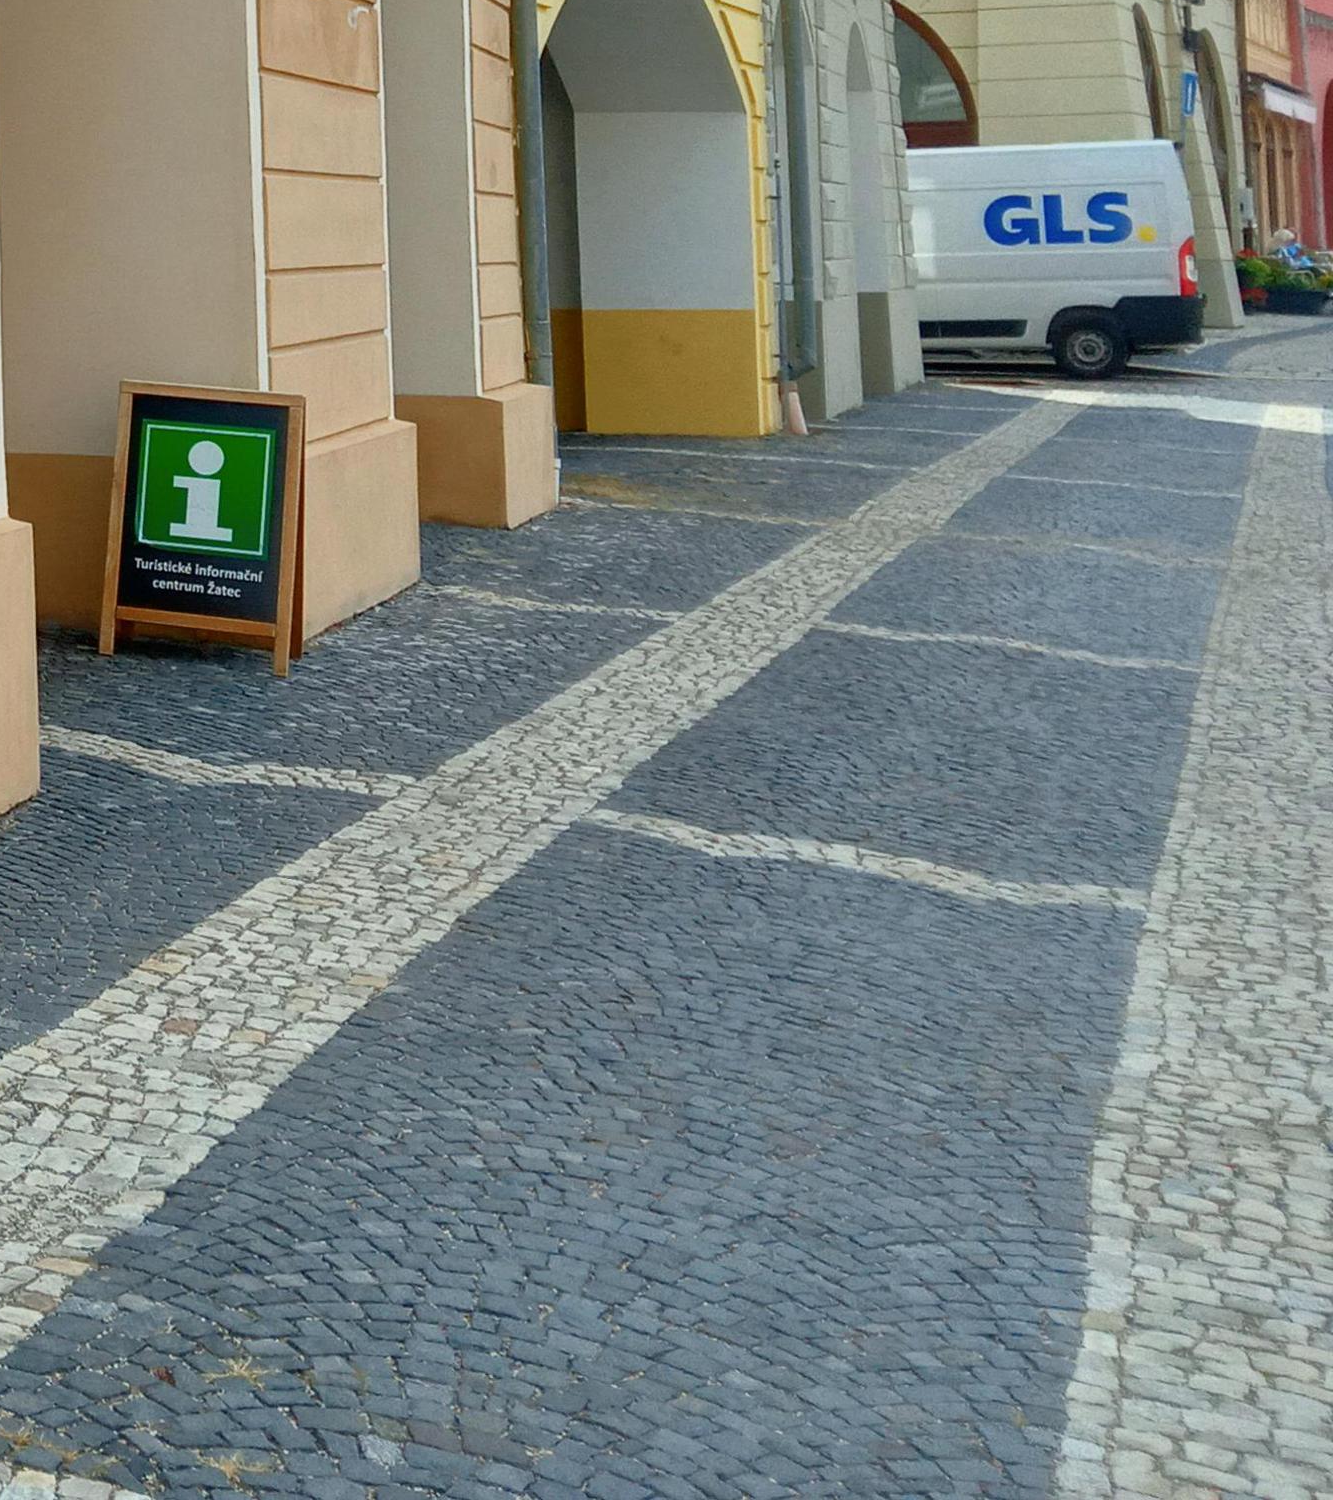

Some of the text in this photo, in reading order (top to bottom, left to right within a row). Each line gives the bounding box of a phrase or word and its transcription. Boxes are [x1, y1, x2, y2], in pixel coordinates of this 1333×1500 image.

[134, 557, 264, 583] Turistické informační
[152, 579, 242, 599] centrum Žatec
